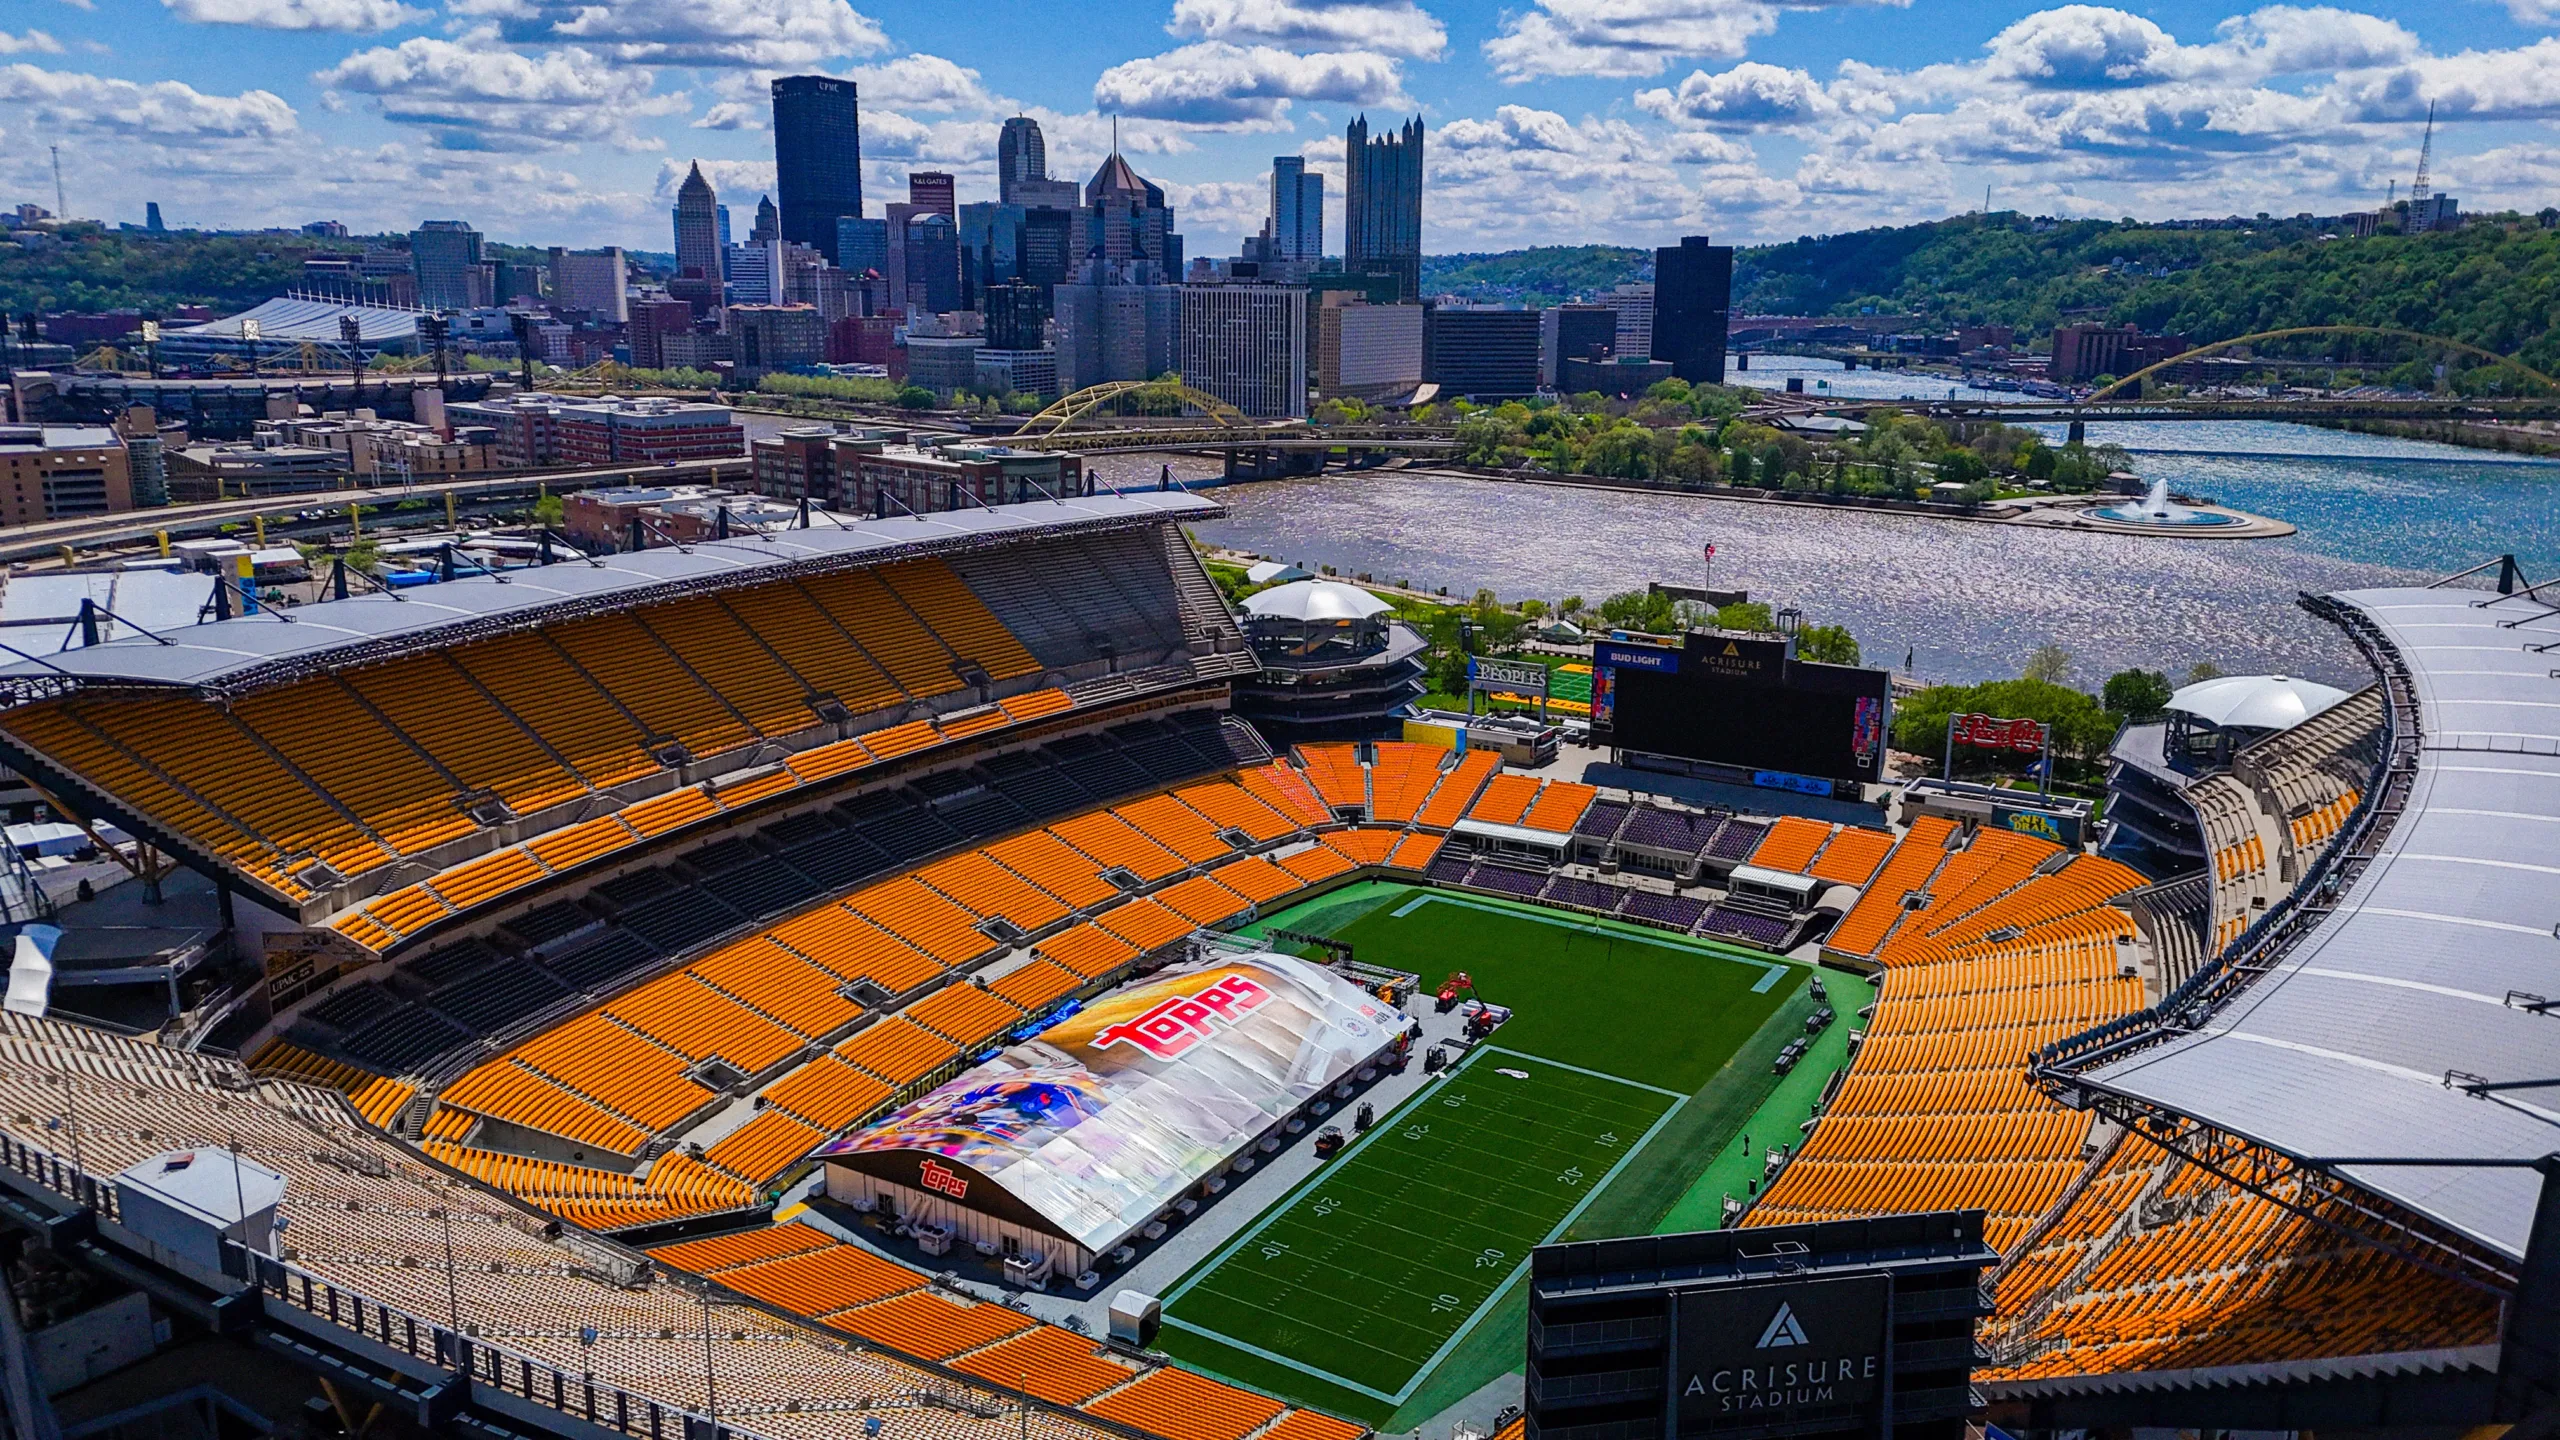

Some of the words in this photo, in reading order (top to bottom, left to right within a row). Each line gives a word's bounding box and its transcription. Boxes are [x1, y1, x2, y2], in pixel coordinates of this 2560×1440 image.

[818, 81, 840, 92] UPMC
[1610, 652, 1632, 664] BUD
[1632, 655, 1662, 667] LIGHT
[1701, 656, 1761, 670] ACRISURE
[1479, 664, 1547, 687] PEOPLES
[1711, 667, 1748, 676] STADIUM
[2013, 821, 2054, 835] DRAFT
[2020, 815, 2047, 827] NFL
[272, 972, 298, 993] UPMC
[1443, 1094, 1467, 1108] 10
[1403, 1124, 1430, 1140] 20
[1594, 1133, 1618, 1148] 10
[1556, 1169, 1583, 1186] 20
[1313, 1196, 1341, 1215] 20
[1261, 1240, 1290, 1257] 10
[1475, 1248, 1505, 1268] 20
[1431, 1294, 1460, 1312] 10
[1684, 1356, 1876, 1397] ACRISURE
[1721, 1386, 1834, 1412] STADIUM
